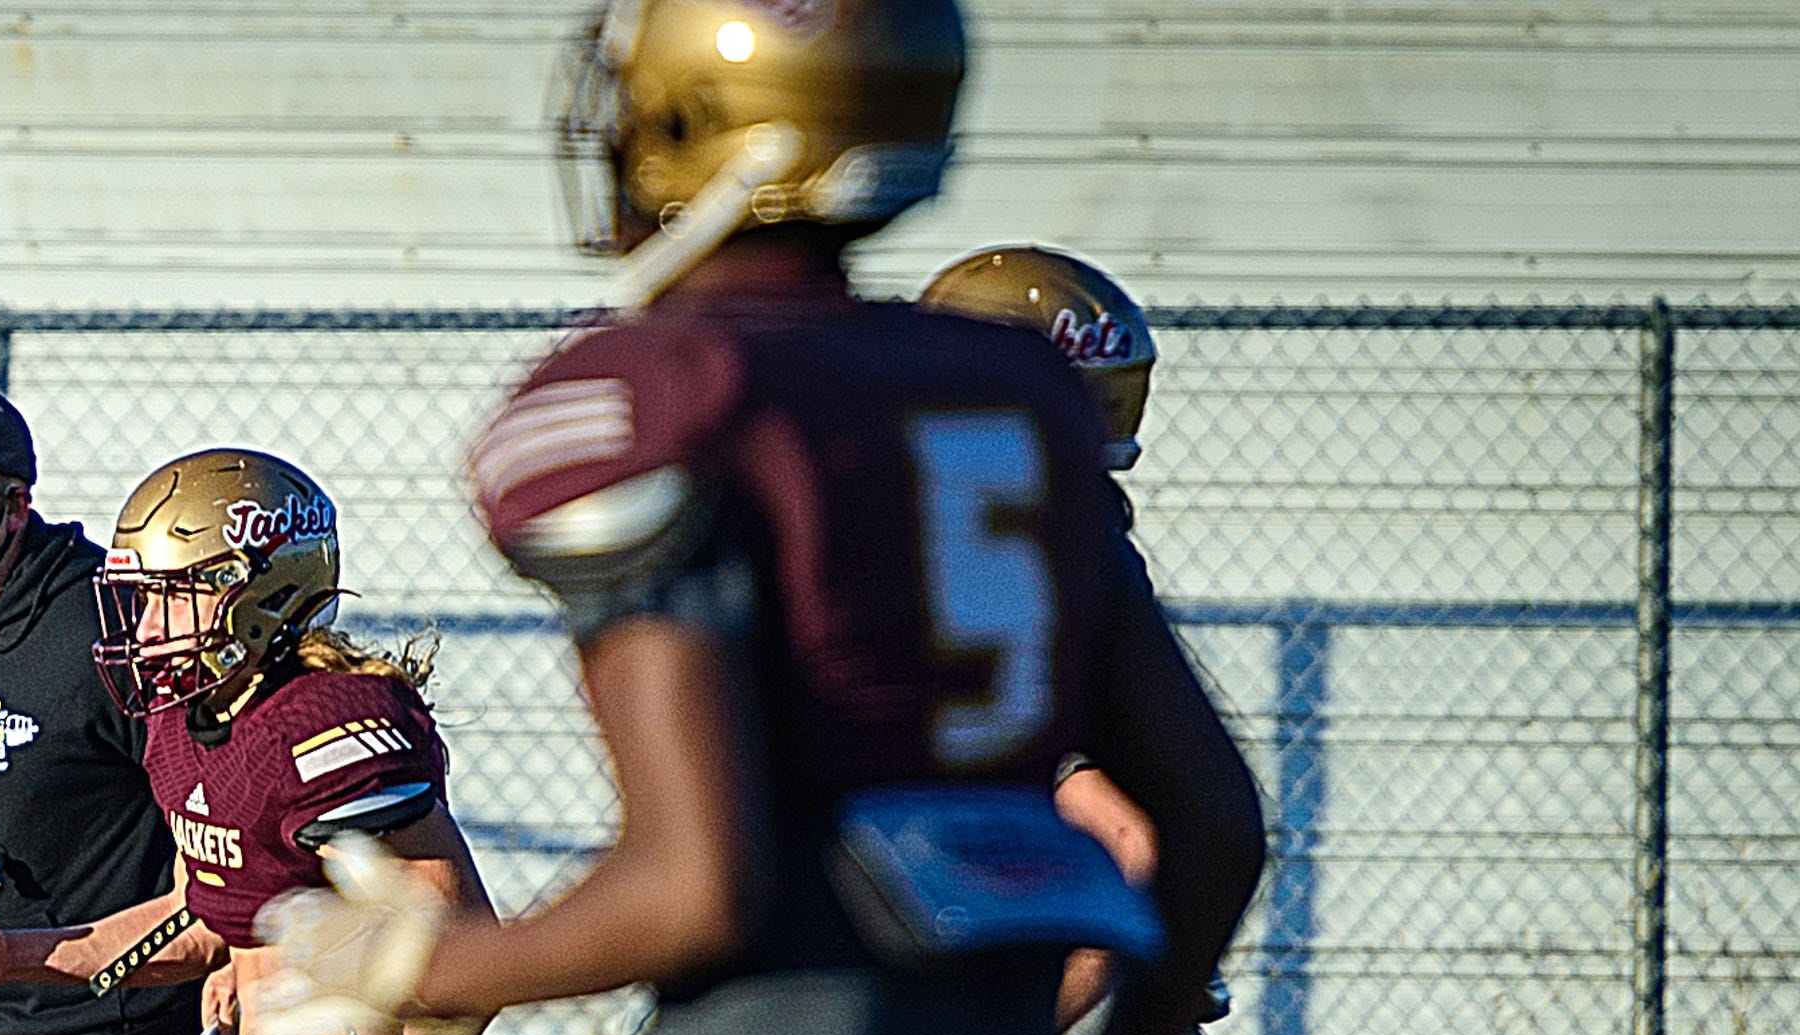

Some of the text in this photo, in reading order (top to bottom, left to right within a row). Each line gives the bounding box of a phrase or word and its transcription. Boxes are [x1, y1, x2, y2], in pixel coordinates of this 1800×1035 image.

[1051, 309, 1134, 366] kets
[222, 494, 336, 548] Jacket
[908, 408, 1054, 764] 5
